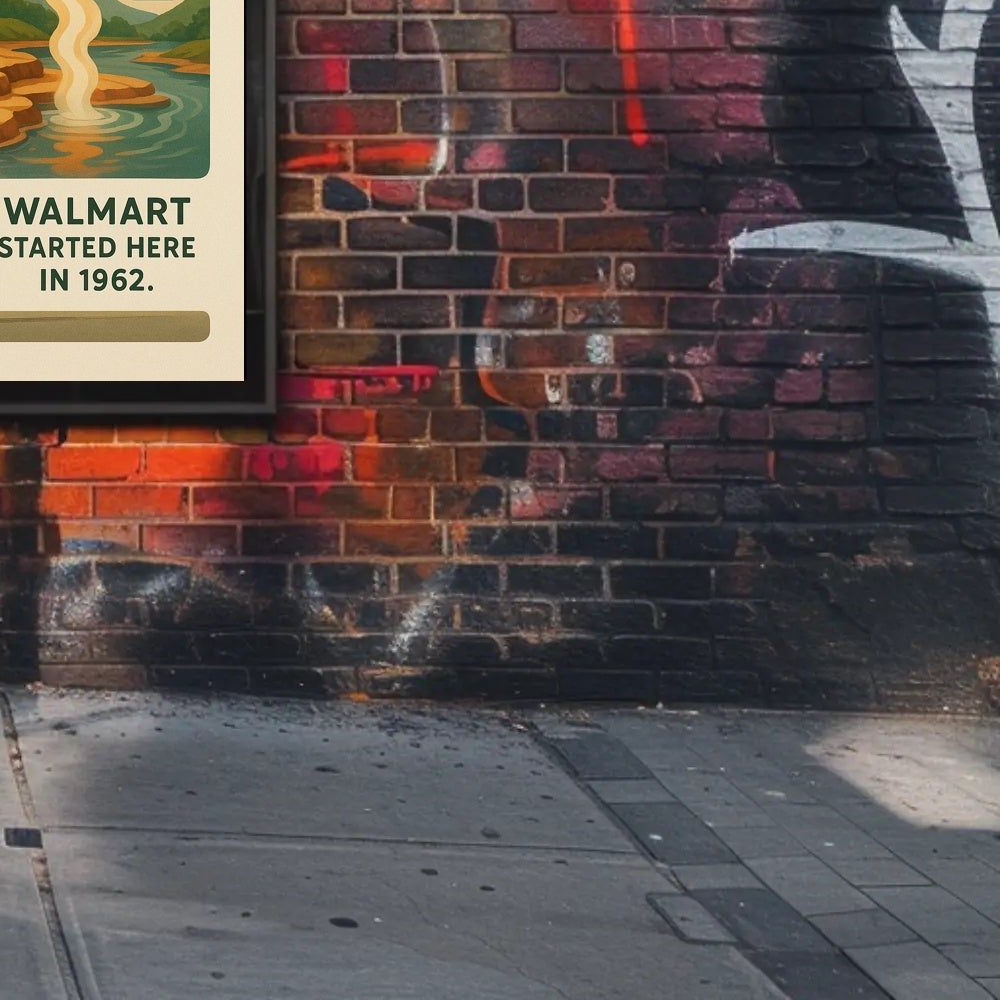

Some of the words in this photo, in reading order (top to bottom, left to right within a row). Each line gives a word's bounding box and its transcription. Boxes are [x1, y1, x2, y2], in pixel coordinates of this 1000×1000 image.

[4, 197, 190, 225] WALMART
[0, 237, 116, 258] STARTED
[128, 237, 195, 258] HERE
[41, 269, 68, 291] IN
[79, 269, 153, 291] 1962.
